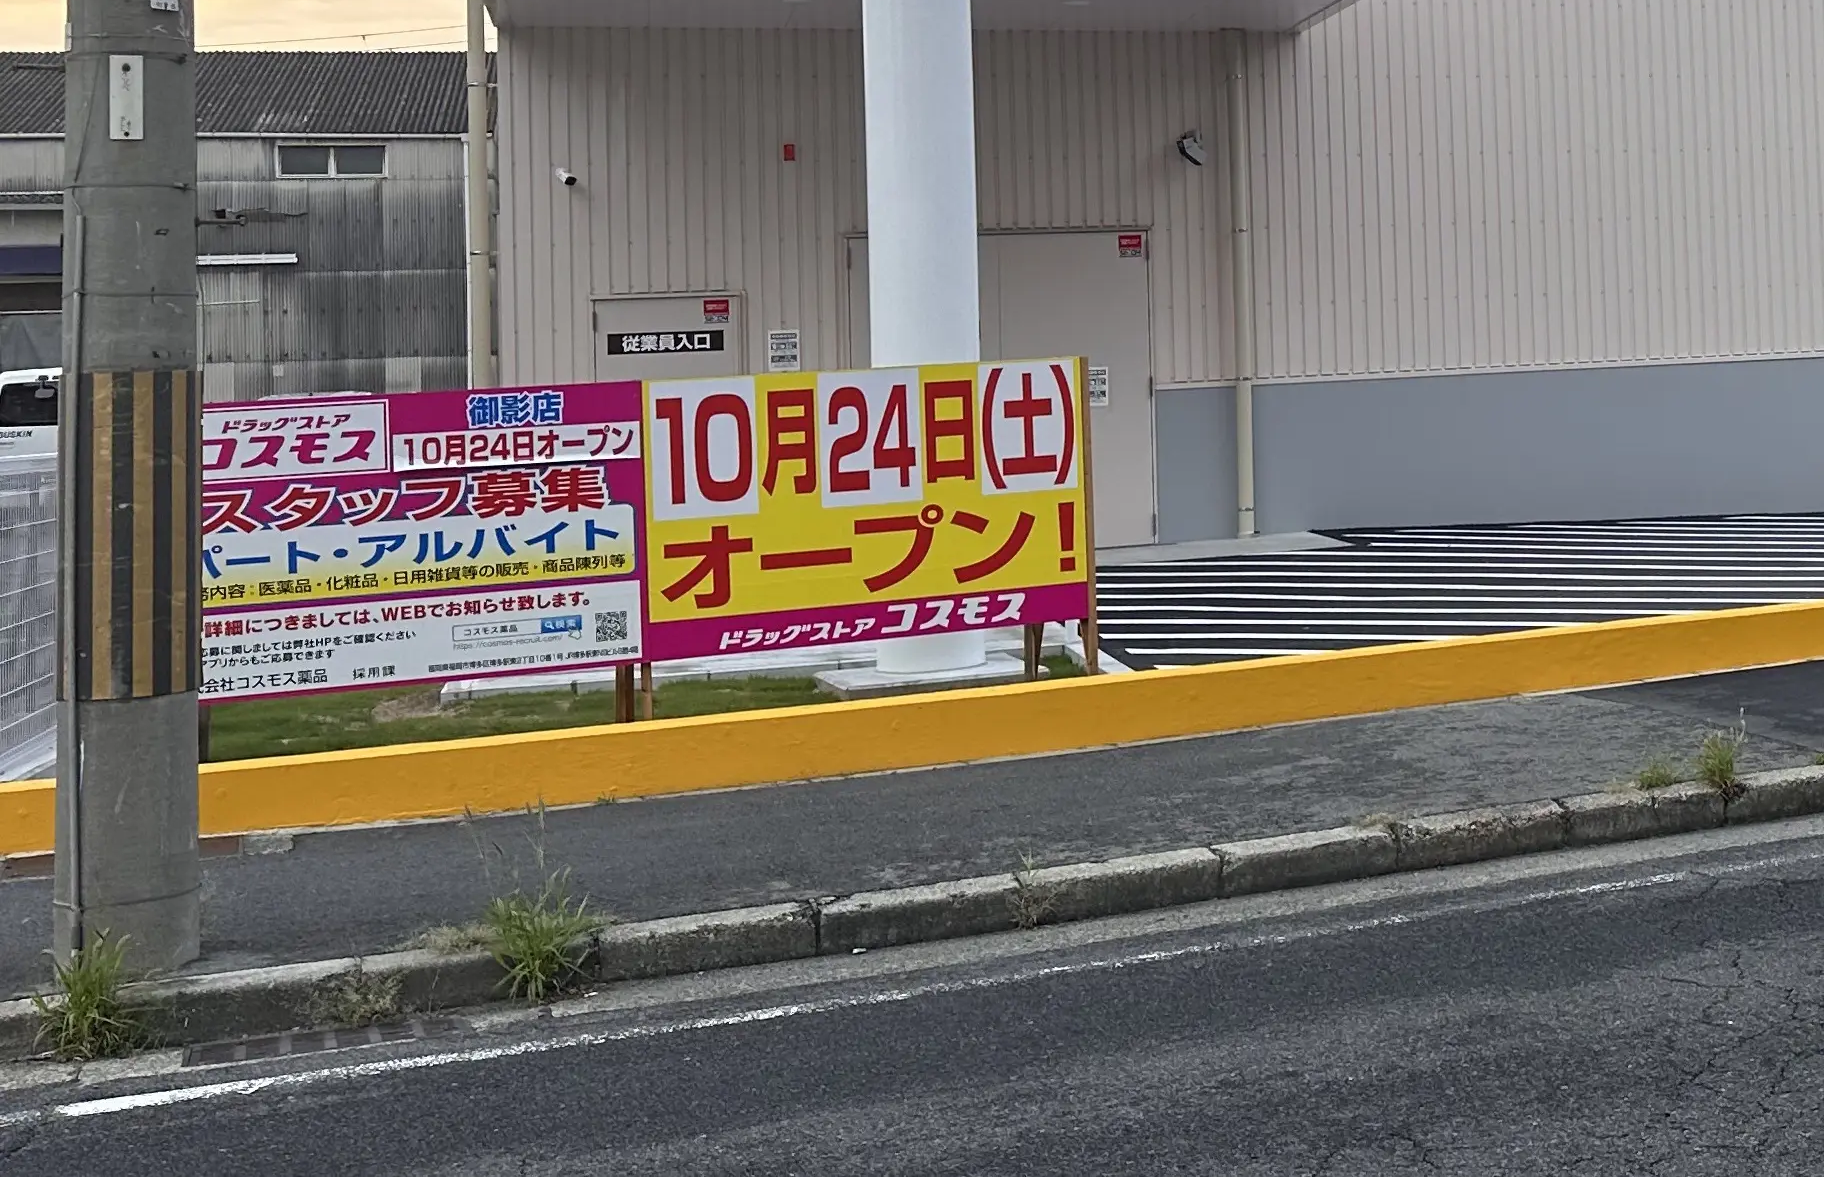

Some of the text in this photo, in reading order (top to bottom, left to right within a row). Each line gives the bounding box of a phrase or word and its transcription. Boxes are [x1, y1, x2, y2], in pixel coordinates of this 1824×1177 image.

[622, 333, 711, 352] 従業員入口
[221, 413, 351, 434] ドラッグストア
[468, 392, 562, 426] 御影店
[202, 430, 376, 471] コスモス
[404, 425, 634, 466] 10月24日オープン
[655, 364, 1075, 506] 10月24日(土)
[202, 467, 606, 535] スタッフ募集
[202, 592, 591, 638] 詳細につきましては、WEBでお知らせ致します。
[718, 592, 1027, 651] ドラッグストア コスモス
[199, 668, 328, 695] 会社コスモス薬品
